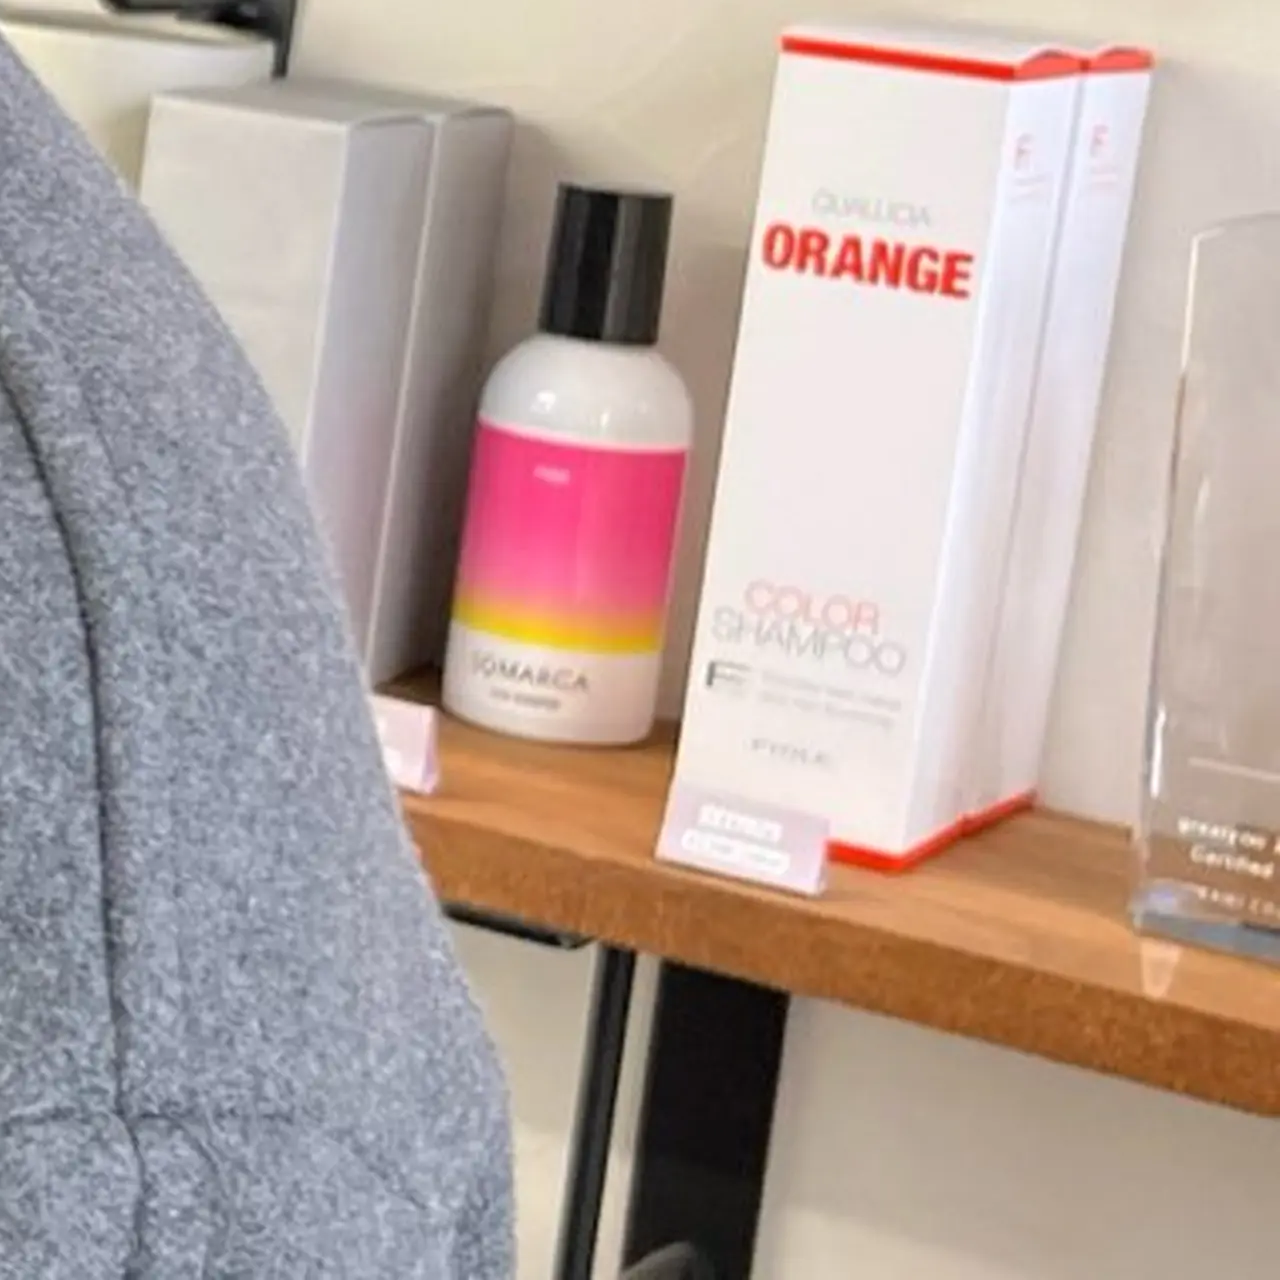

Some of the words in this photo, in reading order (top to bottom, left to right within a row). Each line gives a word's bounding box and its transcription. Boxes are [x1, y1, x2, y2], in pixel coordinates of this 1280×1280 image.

[762, 223, 974, 300] ORANGE
[712, 605, 907, 676] SHAMPOO
[745, 579, 879, 636] COLOR
